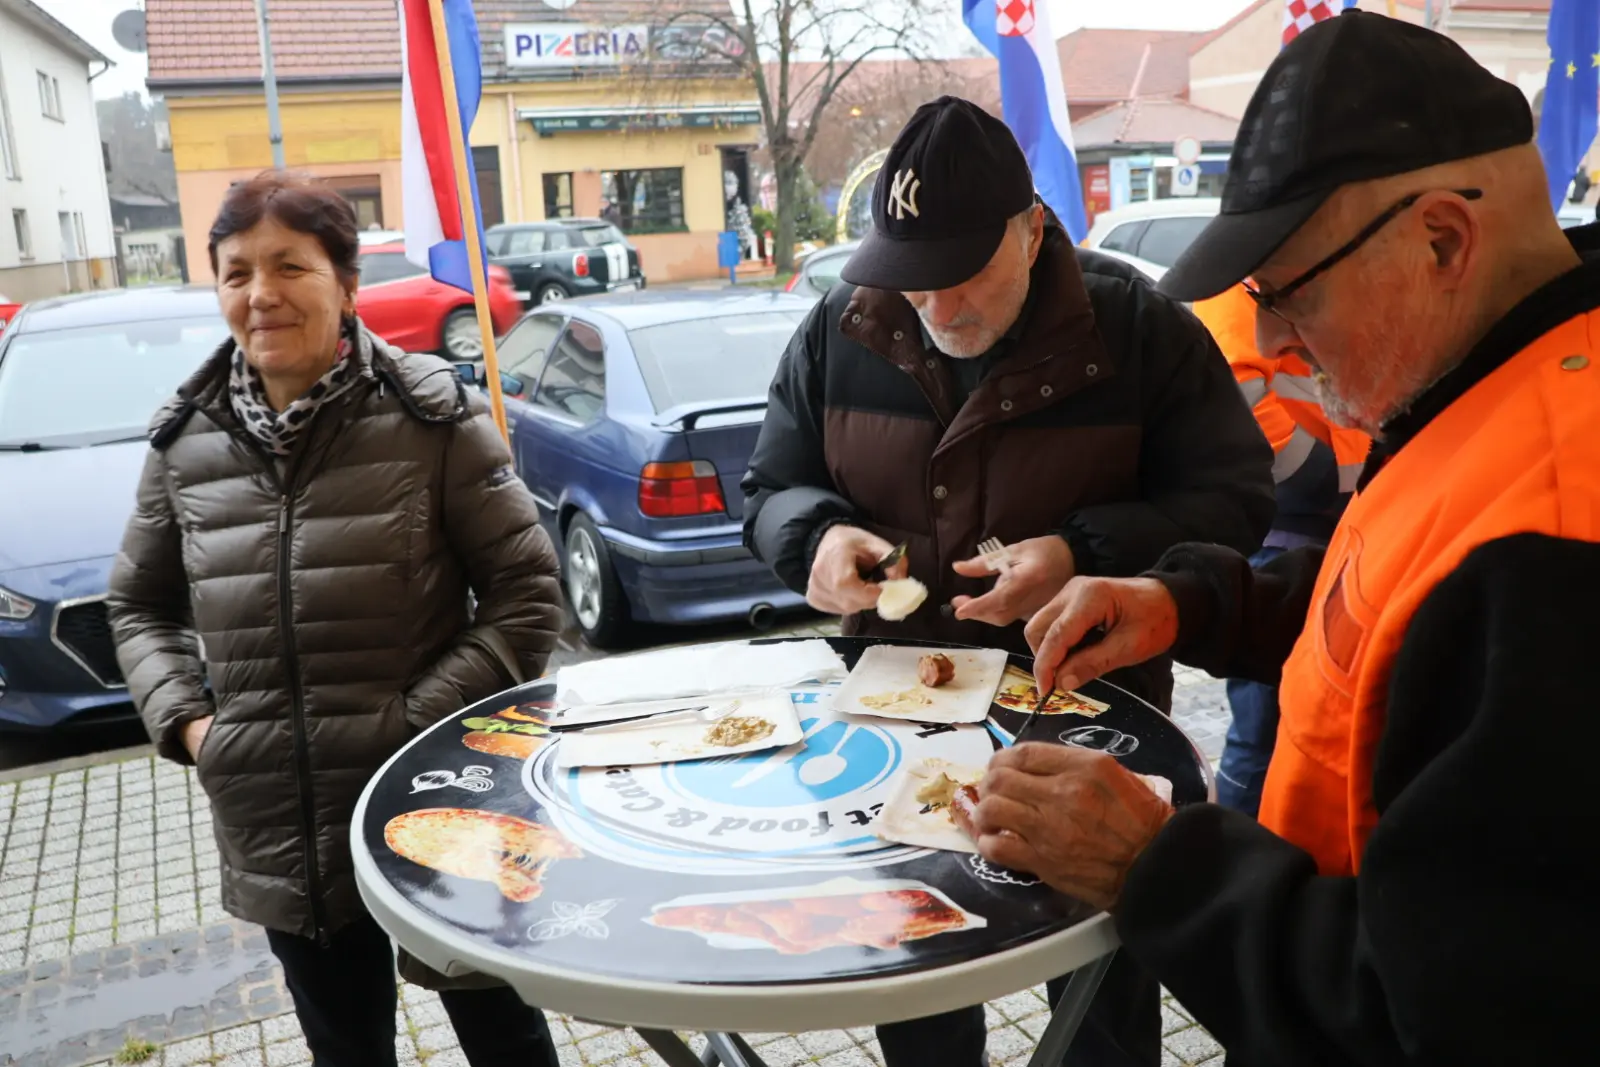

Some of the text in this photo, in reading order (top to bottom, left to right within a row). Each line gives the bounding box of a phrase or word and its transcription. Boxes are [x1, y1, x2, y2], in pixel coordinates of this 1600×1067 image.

[604, 765, 665, 812] Cate
[664, 807, 708, 828] &
[707, 811, 834, 837] food
